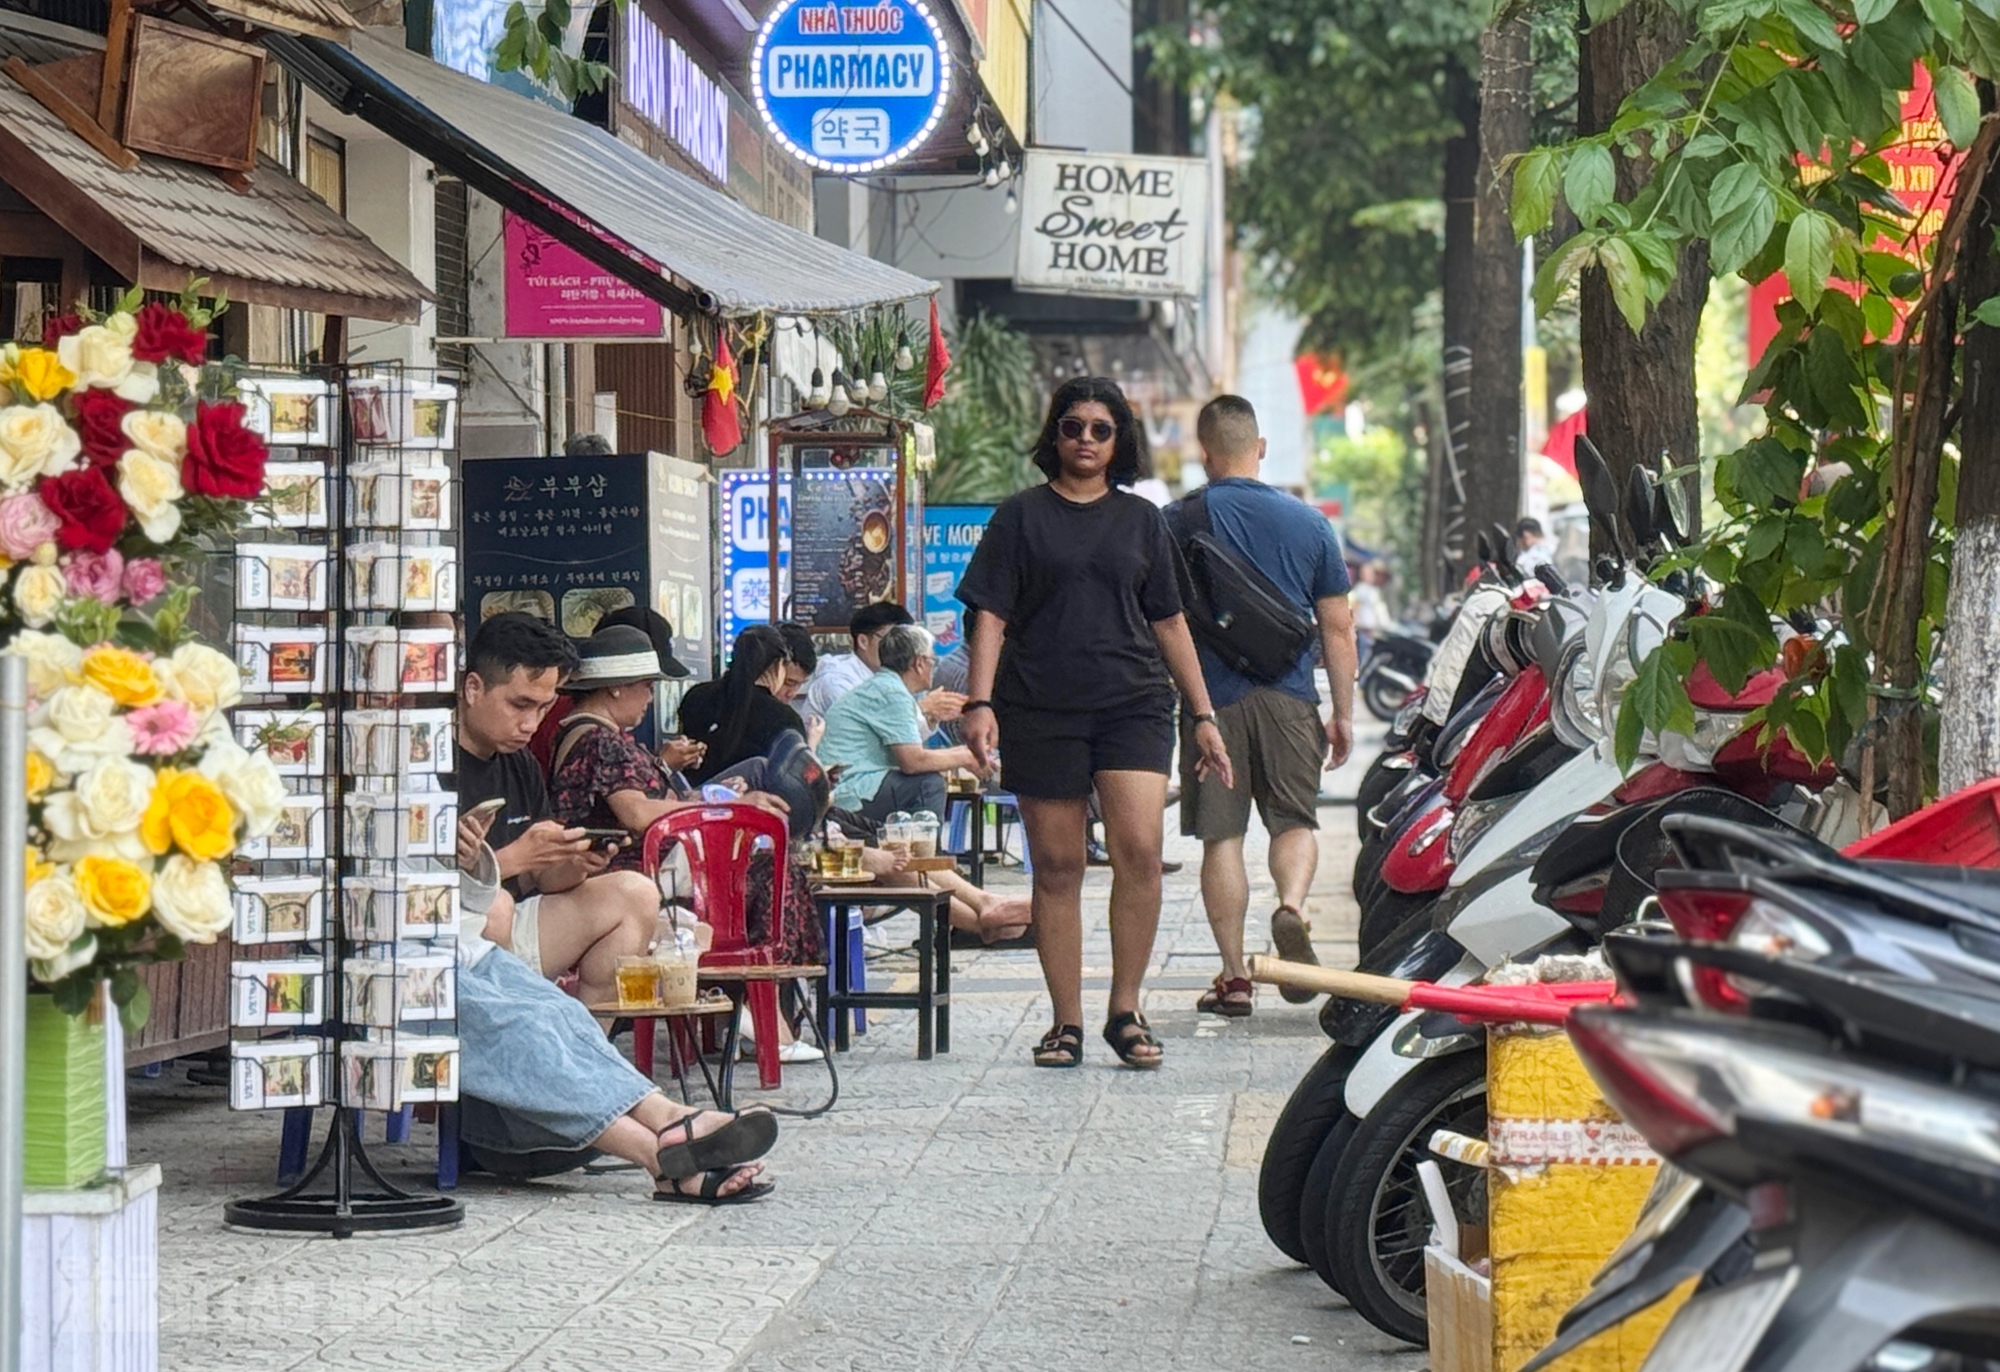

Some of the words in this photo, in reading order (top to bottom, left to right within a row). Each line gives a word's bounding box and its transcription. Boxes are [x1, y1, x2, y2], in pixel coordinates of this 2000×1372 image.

[799, 1, 839, 33] NHÀ
[842, 0, 903, 33] THUỐC
[777, 52, 925, 90] PHARMACY
[669, 38, 729, 186] PHARMACY
[820, 115, 881, 149] 약국
[1055, 163, 1174, 198] HOME
[1908, 164, 1935, 192] XVI
[1034, 195, 1189, 243] Sweet
[1047, 241, 1170, 276] HOME
[549, 274, 581, 287] XÁCH
[538, 473, 609, 499] 부부샵
[1510, 1130, 1572, 1142] FRAGILE
